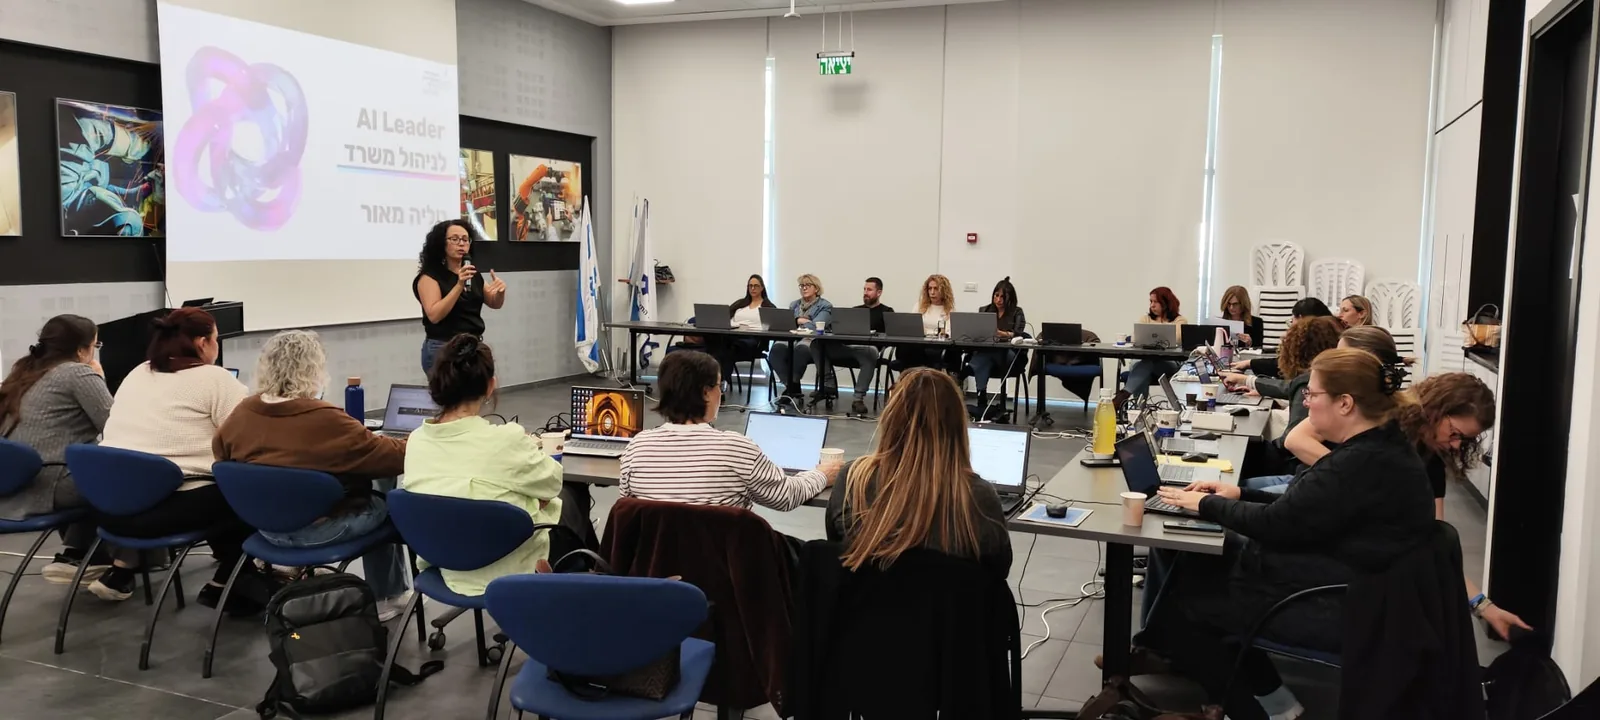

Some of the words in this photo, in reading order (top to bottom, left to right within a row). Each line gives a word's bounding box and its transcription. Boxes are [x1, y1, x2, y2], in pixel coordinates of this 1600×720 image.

[820, 57, 851, 75] יציאה
[356, 107, 377, 131] AI
[383, 111, 446, 139] Leader
[344, 144, 396, 166] משרד
[398, 146, 447, 172] לניהול
[360, 204, 405, 224] מאור
